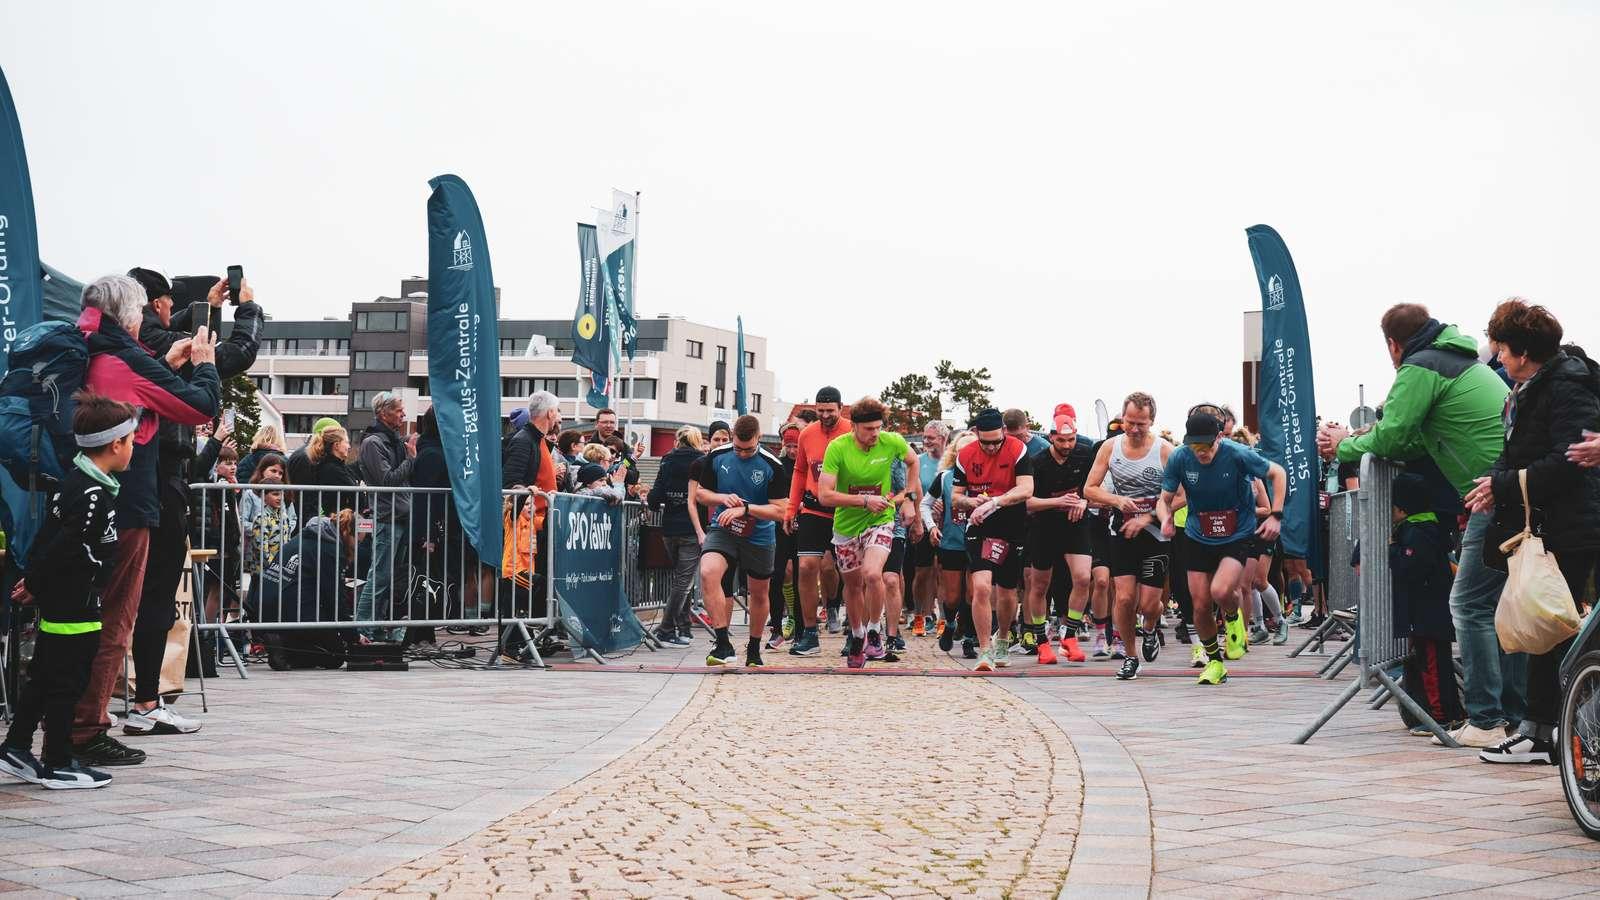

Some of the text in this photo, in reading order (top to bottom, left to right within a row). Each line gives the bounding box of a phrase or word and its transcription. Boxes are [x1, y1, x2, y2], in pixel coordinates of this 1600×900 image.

[1286, 346, 1311, 480] St. Peter-Ording
[566, 511, 612, 550] SPO läuft
